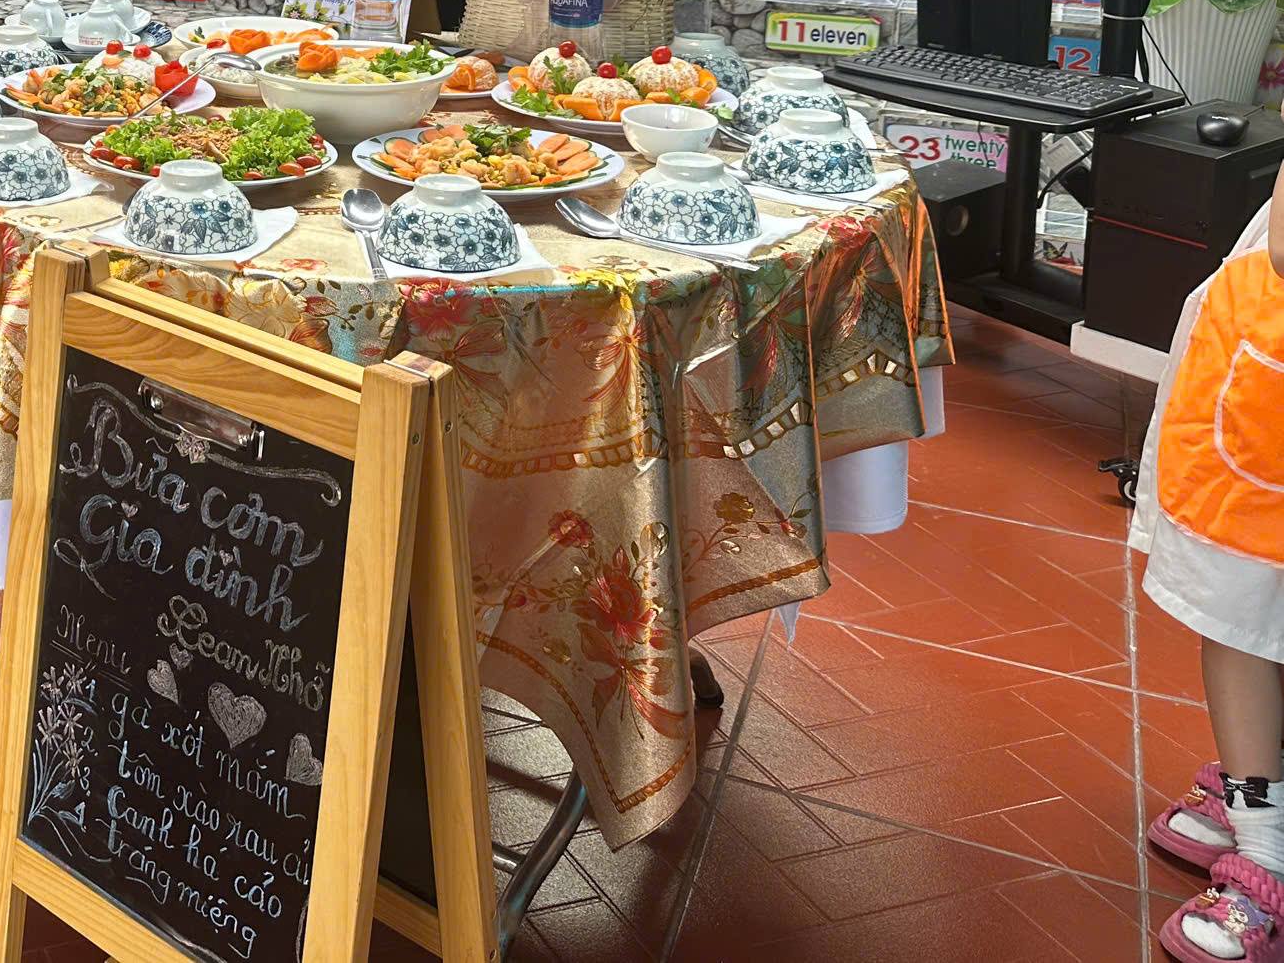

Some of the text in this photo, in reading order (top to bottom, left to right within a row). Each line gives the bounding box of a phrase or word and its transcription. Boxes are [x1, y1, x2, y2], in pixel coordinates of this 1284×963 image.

[778, 20, 868, 46] 11 eleven
[1054, 46, 1093, 72] 12
[898, 134, 1005, 161] 23 twenty
[53, 493, 309, 632] Gia đình
[201, 486, 324, 567] cơm
[56, 604, 132, 675] Menu
[107, 740, 165, 799] tôm
[172, 781, 220, 831] xào
[225, 812, 279, 865] rau
[161, 710, 205, 769] xốt
[216, 749, 307, 820] mắm
[182, 823, 228, 881] há
[234, 871, 282, 918] cảo
[177, 881, 258, 959] miệng
